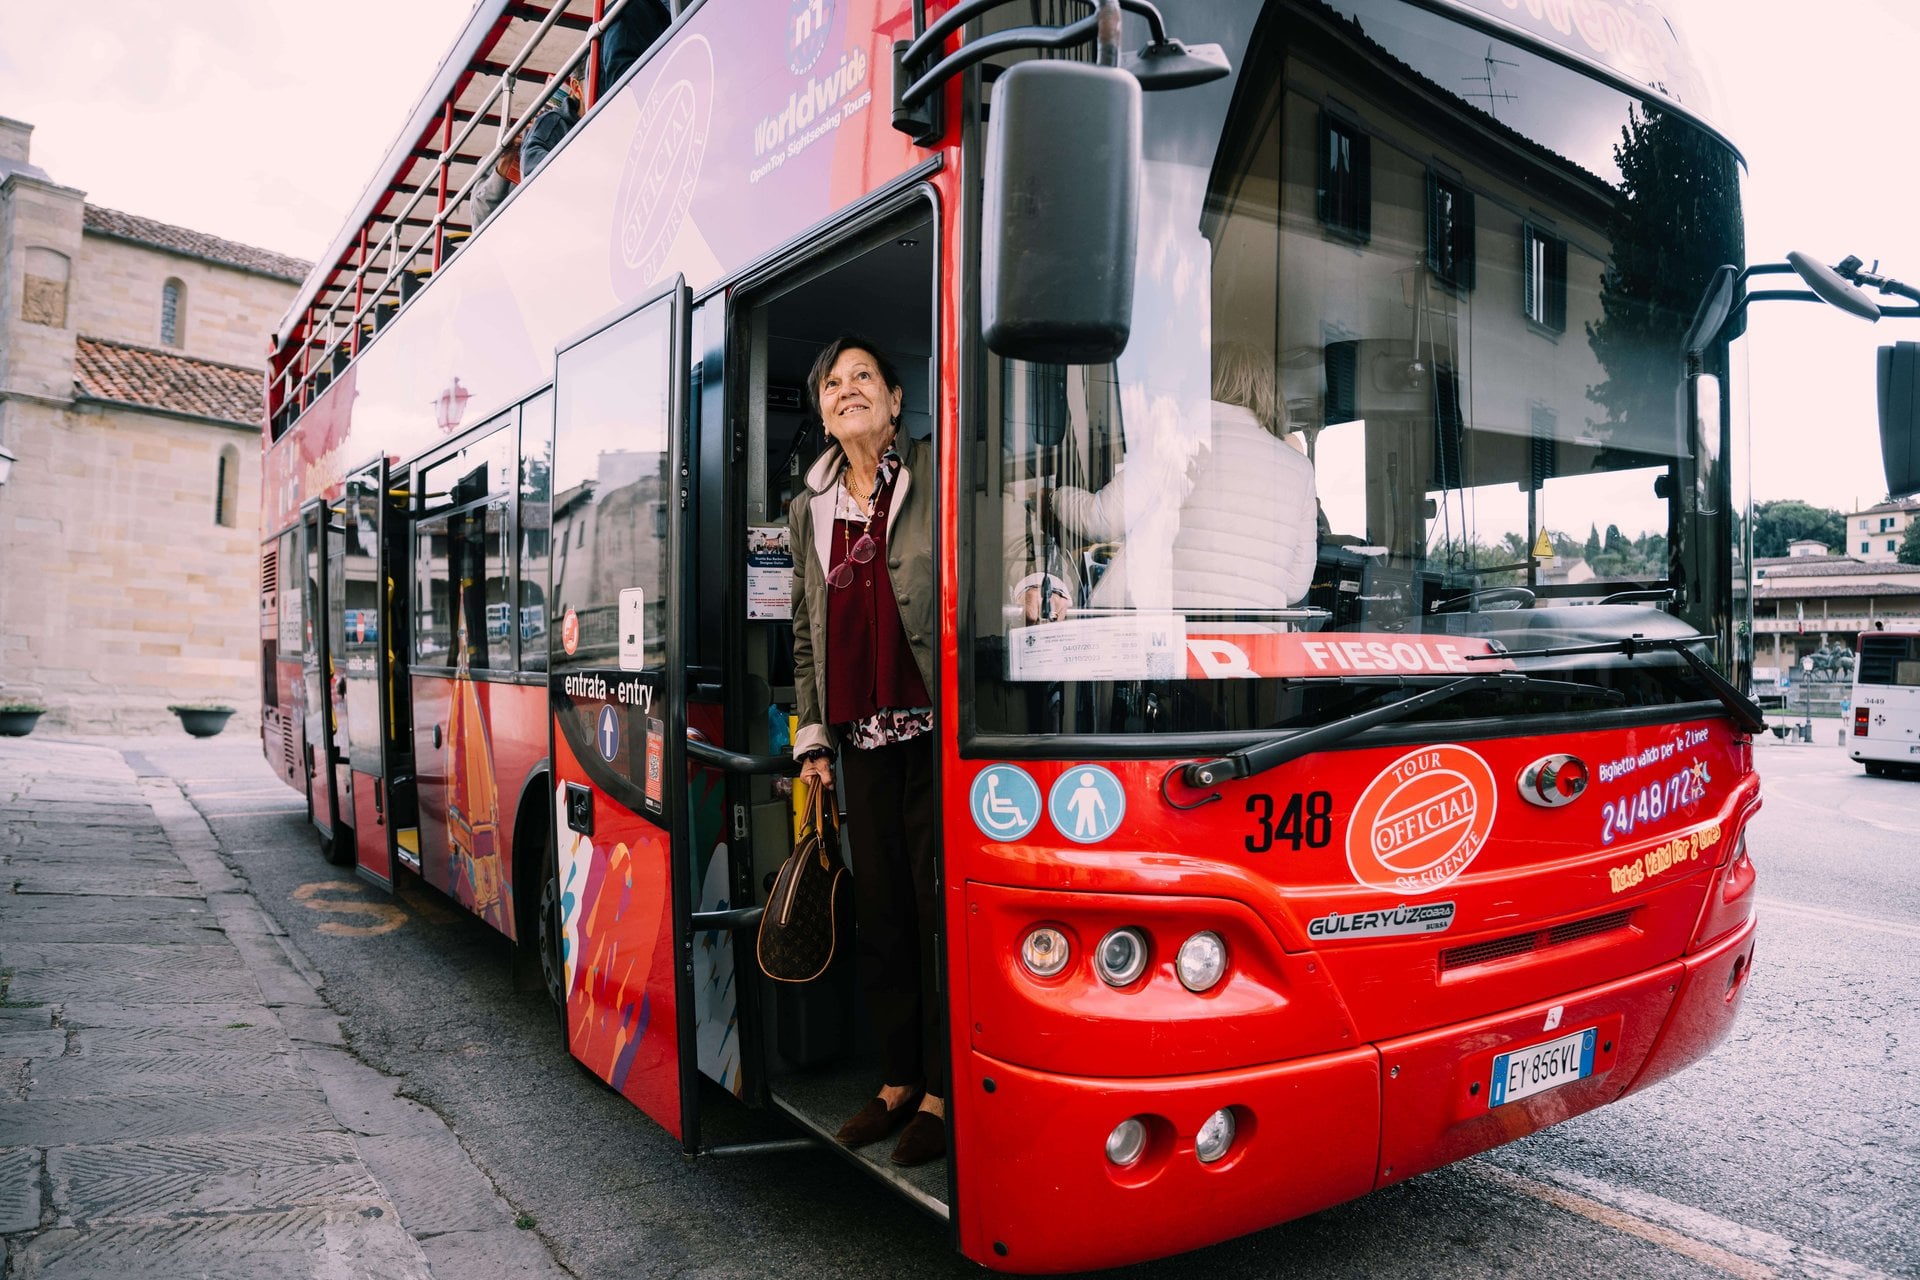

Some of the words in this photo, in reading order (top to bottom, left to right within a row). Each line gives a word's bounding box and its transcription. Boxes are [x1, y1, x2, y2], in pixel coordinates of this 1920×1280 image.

[755, 48, 867, 156] Worldwide
[787, 111, 842, 158] Sightseeing
[842, 90, 872, 118] Tours
[625, 100, 693, 254] OFFICIAL
[660, 131, 705, 255] FIRENZE
[1152, 632, 1167, 647] M
[1301, 641, 1468, 672] FIESOLE
[565, 671, 607, 700] entrata
[618, 677, 654, 715] entry
[1391, 752, 1442, 784] TOUR
[1599, 755, 1636, 782] Biglietto
[1637, 747, 1659, 767] valido
[1661, 742, 1674, 760] per
[1676, 736, 1684, 751] le
[1685, 730, 1691, 748] 2
[1244, 790, 1332, 854] 348
[1376, 791, 1474, 851] OFFICIAL
[1602, 767, 1691, 843] 24/48/72
[1395, 877, 1420, 889] OF
[1420, 830, 1481, 886] FIRENZE
[1609, 858, 1645, 893] Ticket
[1645, 843, 1672, 877] Valid
[1691, 833, 1698, 861] 2
[1309, 904, 1420, 936] GÜLERYÜZ
[1420, 906, 1451, 919] COBRA
[1425, 922, 1448, 931] BURSA
